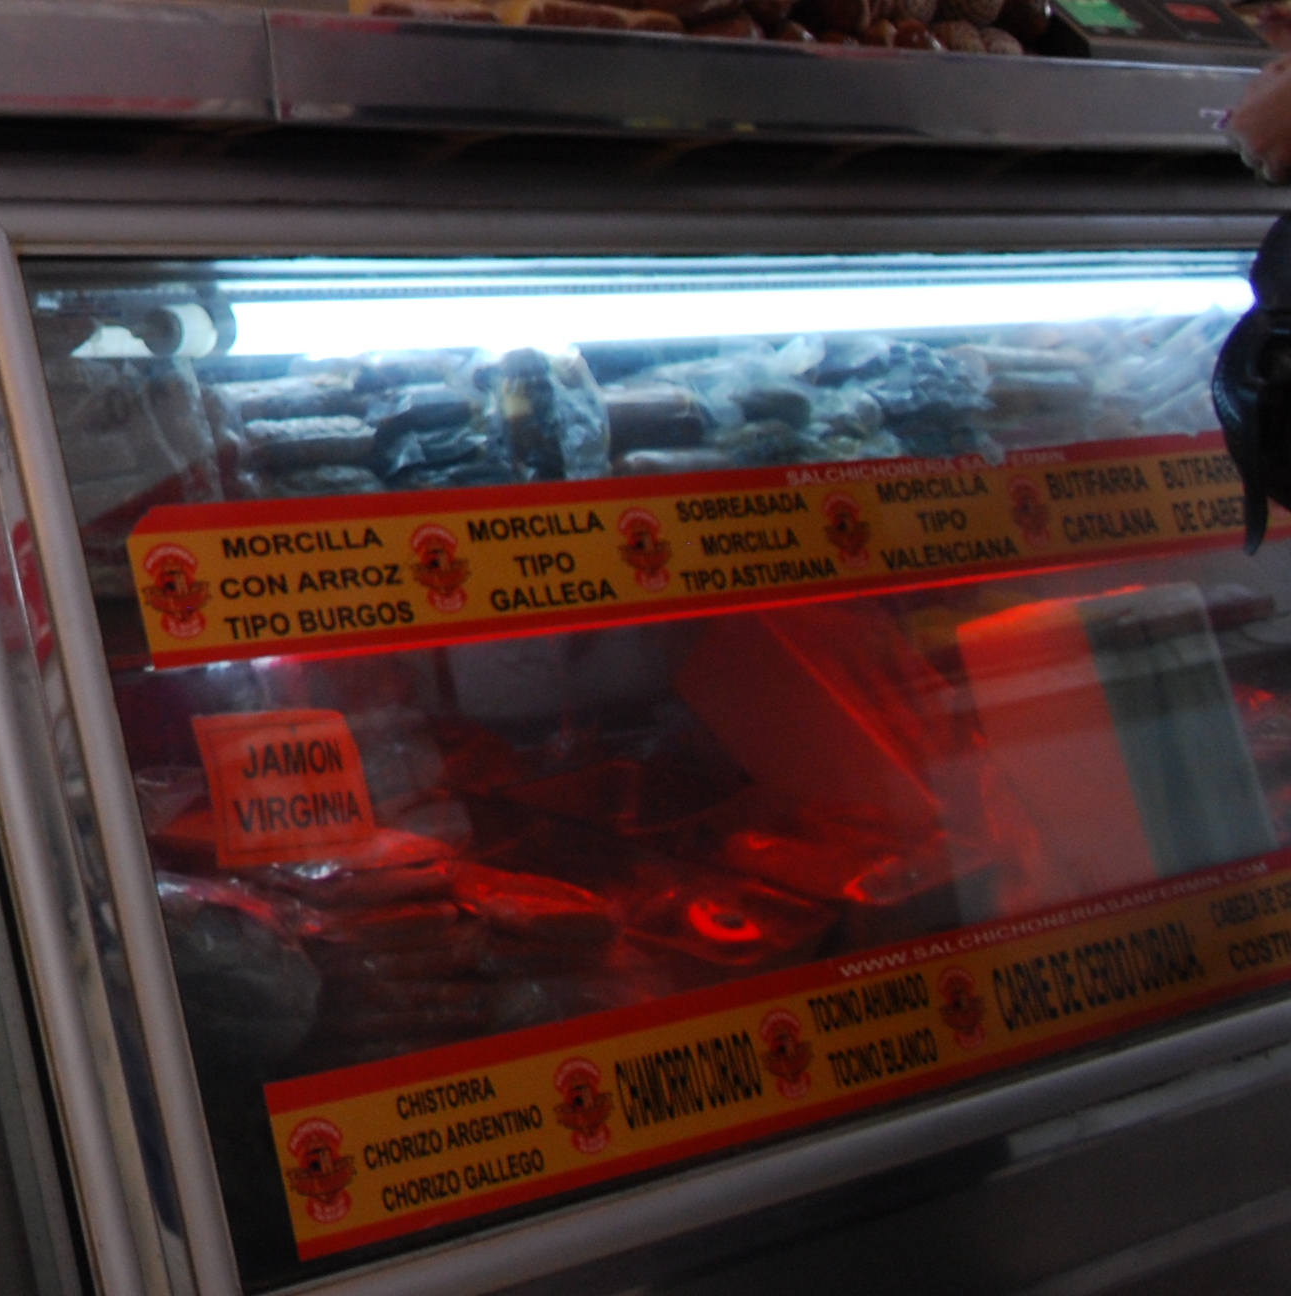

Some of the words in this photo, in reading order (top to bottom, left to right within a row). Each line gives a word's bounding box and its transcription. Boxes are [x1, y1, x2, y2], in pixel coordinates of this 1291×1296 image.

[876, 474, 990, 505] MORCILLA
[1045, 465, 1149, 500] BUTIFARRA
[468, 510, 605, 544] MORCILLA
[676, 492, 809, 524] SOBREASADA
[917, 508, 968, 533] TIPO
[1063, 506, 1160, 544] CATALANA
[1172, 501, 1199, 534] DE
[222, 527, 383, 560] MORCILLA
[701, 527, 800, 557] MORCILLA
[880, 537, 1021, 572] VALENCIANA
[220, 573, 289, 600] CON
[298, 564, 403, 593] ARROZ
[514, 551, 575, 580] TIPO
[680, 568, 727, 594] TIPO
[730, 556, 838, 589] ASTURIANA
[490, 578, 617, 614] GALLEGA
[225, 613, 291, 641] TIPO
[299, 600, 416, 634] BURGOS
[241, 739, 344, 781] JAMON
[233, 789, 364, 835] VIRGINIA
[807, 987, 863, 1035] TOCINO
[991, 955, 1060, 1033] CARNE
[697, 1029, 764, 1110] CURADO
[827, 1042, 884, 1089] TOCINO
[879, 1026, 940, 1075] BLANCO
[396, 1075, 497, 1123] CHISTORRA
[363, 1127, 443, 1171] CHORIZO
[446, 1104, 544, 1152] ARGENTINO
[381, 1169, 462, 1214] CHORIZO
[464, 1148, 546, 1191] GALLEGO
